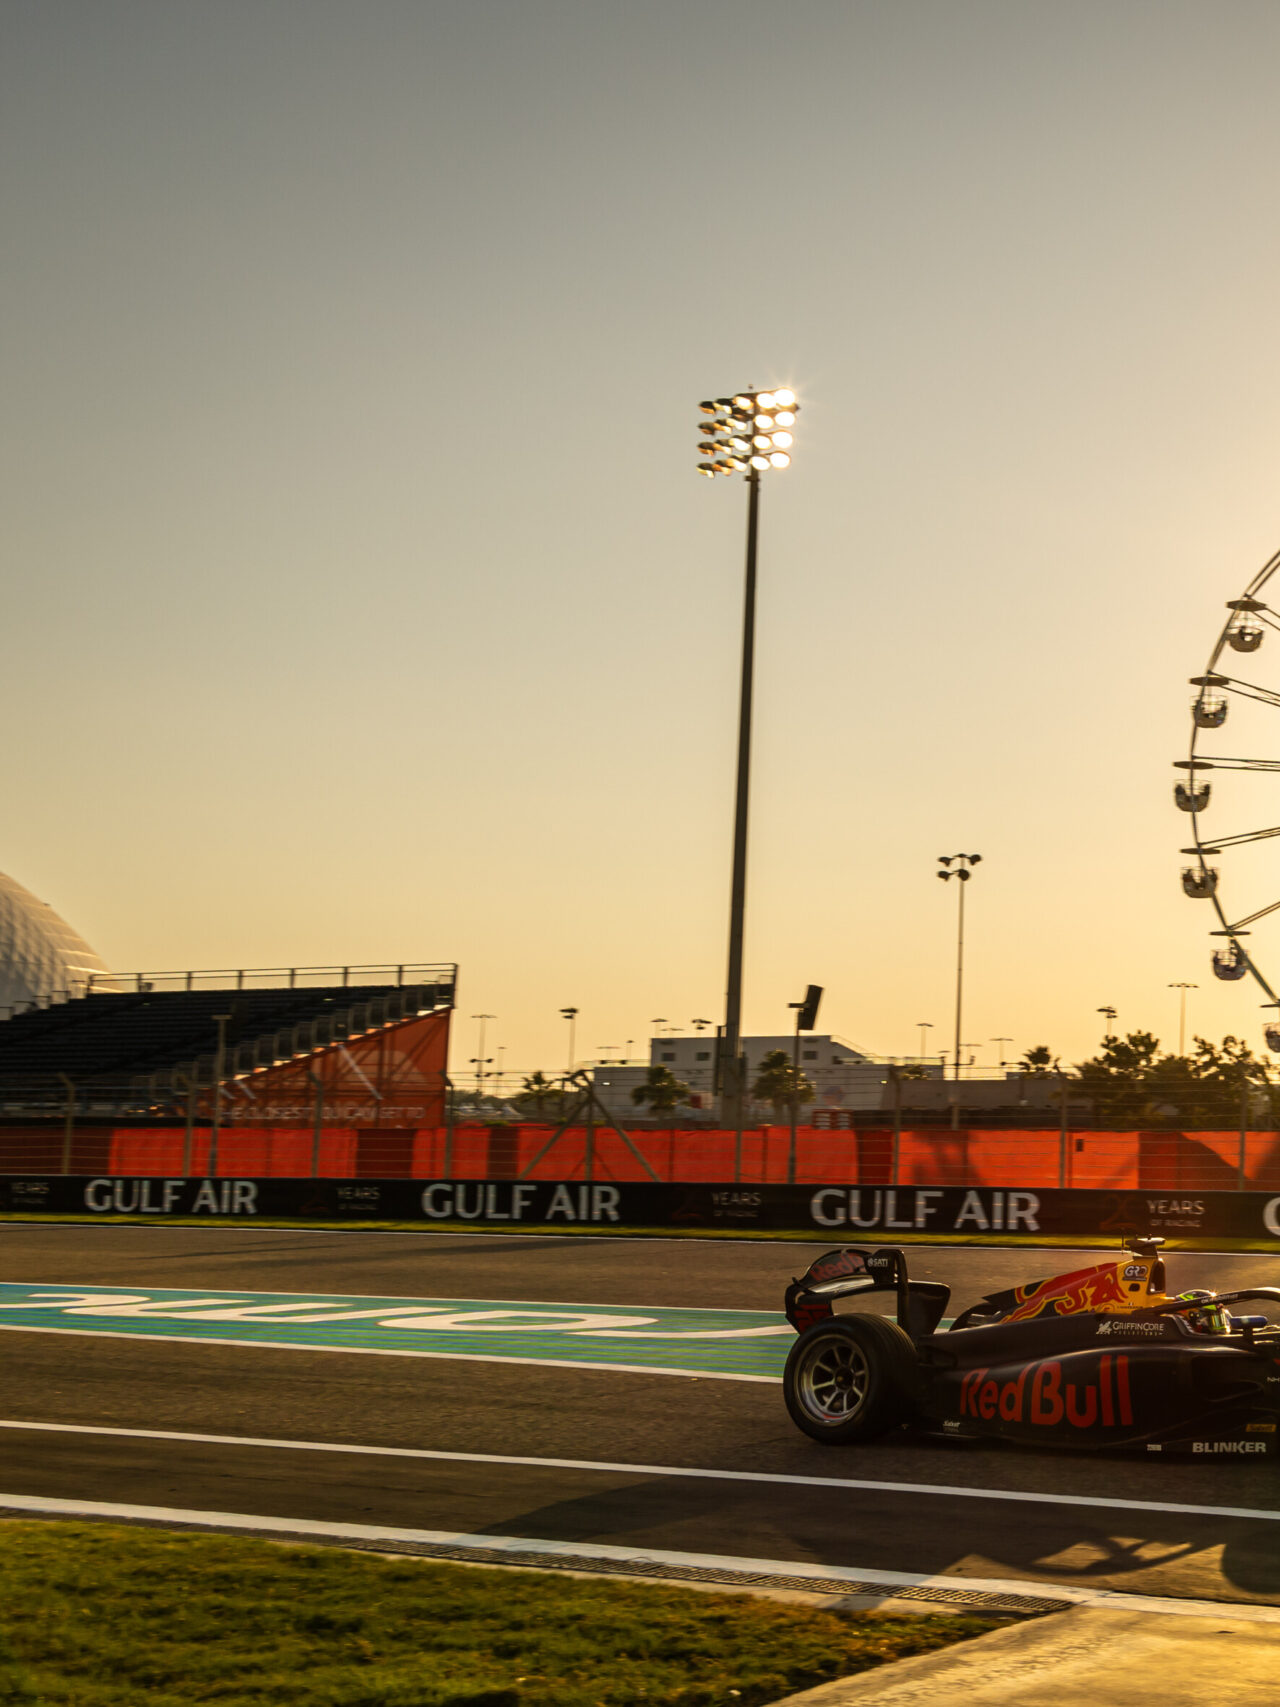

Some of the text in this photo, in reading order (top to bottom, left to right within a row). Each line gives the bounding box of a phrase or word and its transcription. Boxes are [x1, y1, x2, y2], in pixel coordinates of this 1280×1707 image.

[84, 1178, 259, 1215] GULF AIR
[420, 1183, 537, 1220] GULF
[544, 1184, 621, 1222] AIR
[711, 1191, 761, 1206] YEARS
[810, 1188, 1041, 1232] GULF AIR
[1145, 1199, 1205, 1216] YEARS
[960, 1354, 1135, 1429] Red Bull
[1192, 1441, 1267, 1453] BLINKER
